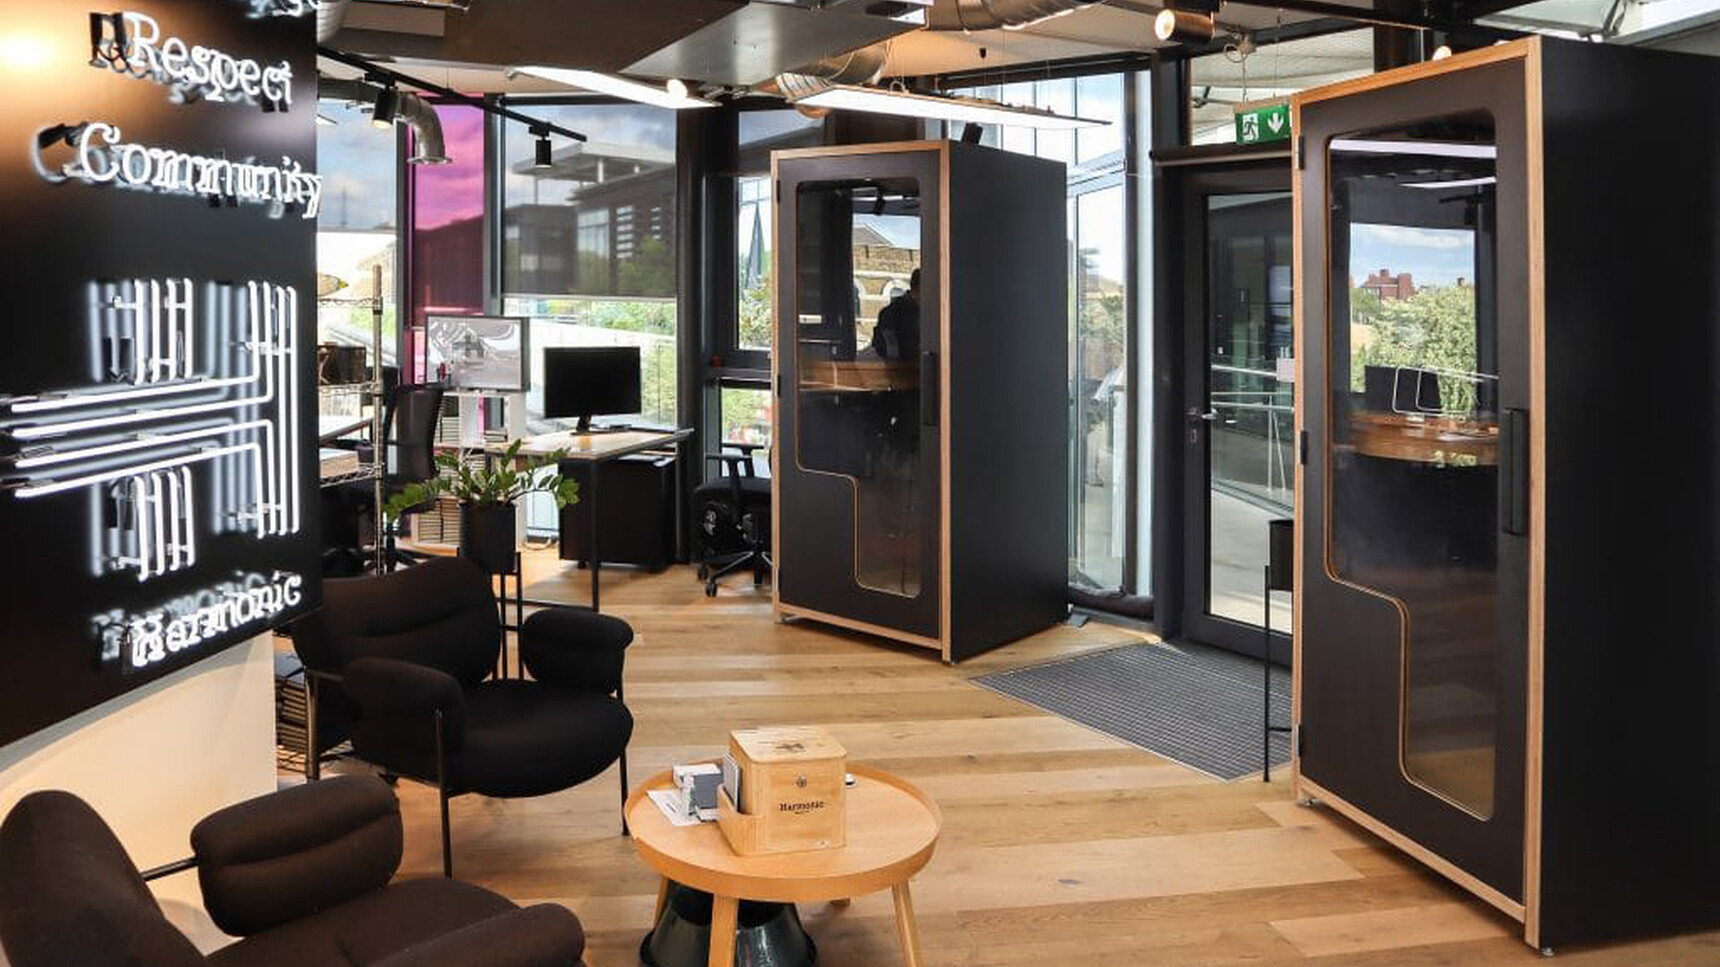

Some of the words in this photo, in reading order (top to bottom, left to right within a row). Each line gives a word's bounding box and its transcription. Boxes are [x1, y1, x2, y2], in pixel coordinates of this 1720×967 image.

[123, 11, 293, 104] Respect
[80, 122, 322, 219] Community
[131, 570, 302, 667] Harmonic
